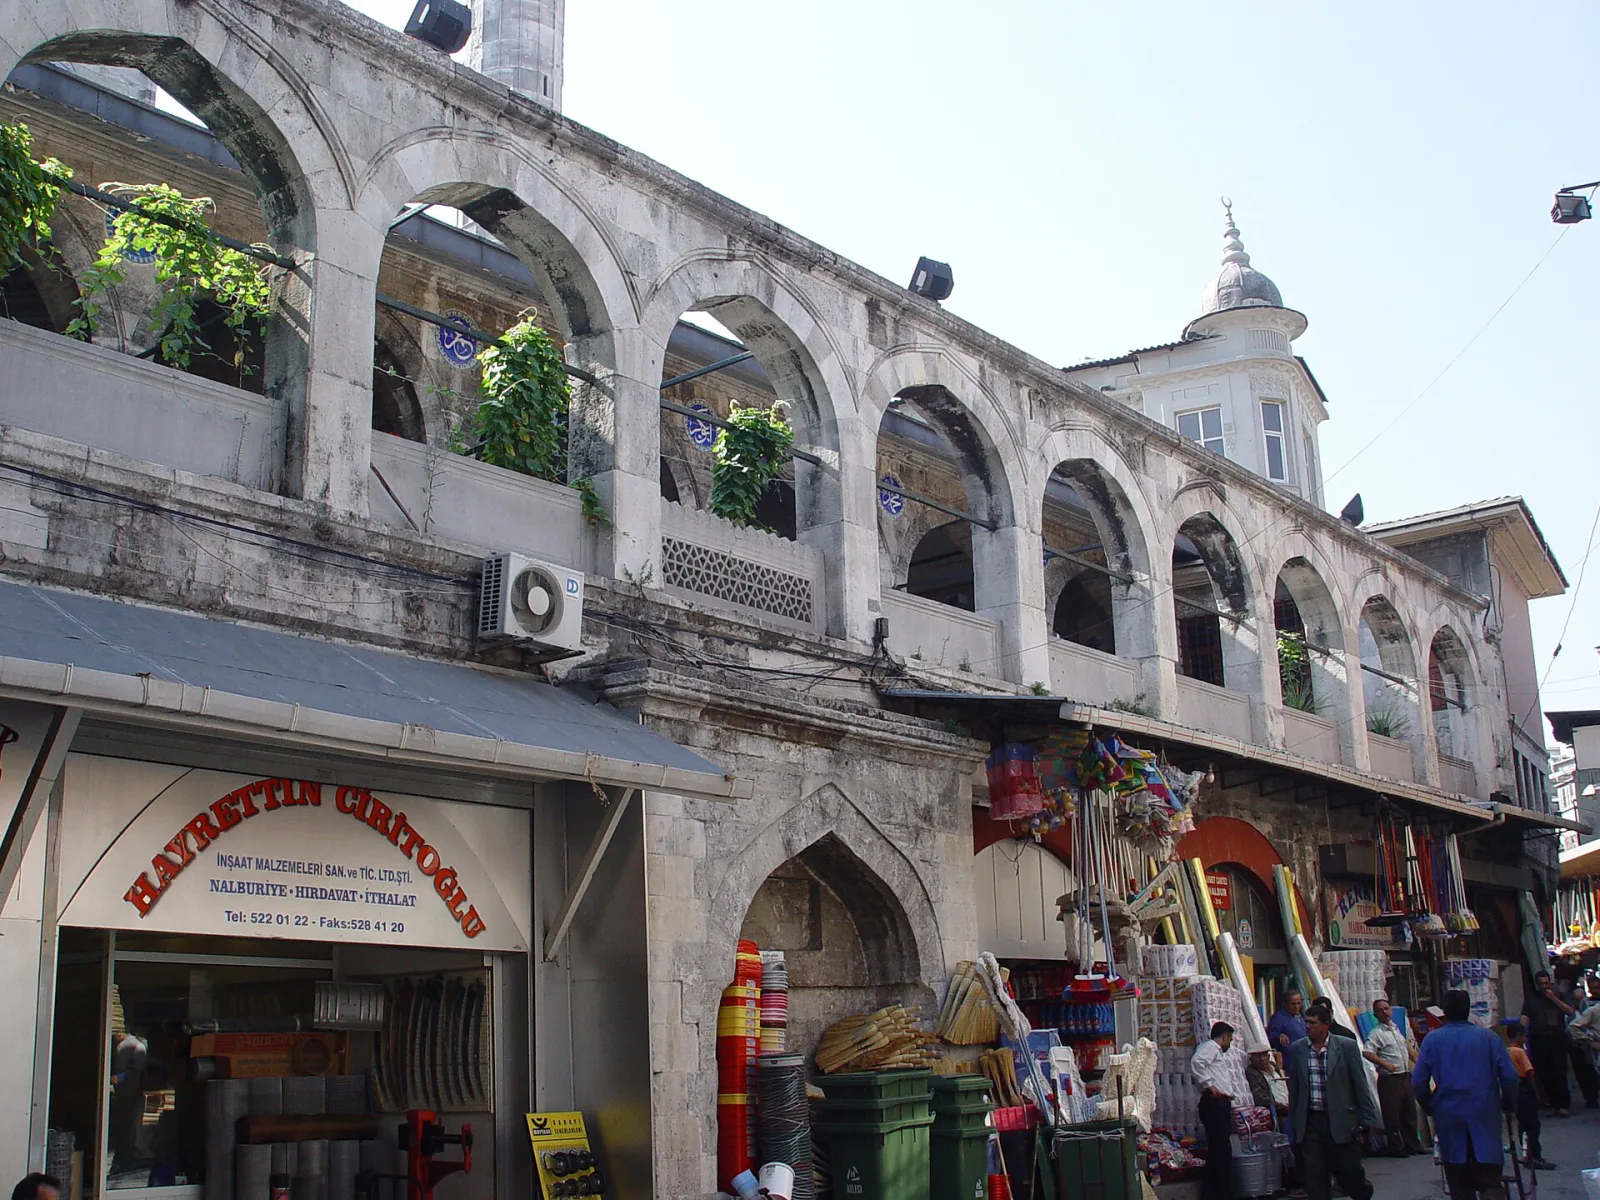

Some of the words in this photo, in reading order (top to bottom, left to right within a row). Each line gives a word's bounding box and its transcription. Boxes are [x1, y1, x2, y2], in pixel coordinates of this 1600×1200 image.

[216, 852, 253, 872] İNŞAAT
[255, 857, 323, 876] MALZEMELERİ
[325, 864, 346, 878] SAN.
[347, 868, 358, 879] ve
[360, 866, 377, 881] TİC.
[335, 785, 486, 938] CİRİTOĞLU
[209, 879, 288, 897] NALBURİYE
[295, 886, 358, 902] HIRDAVAT
[364, 887, 417, 907] İTHALAT
[225, 910, 247, 923] Tel:
[250, 912, 273, 925] 522
[276, 914, 290, 925] 01
[294, 915, 309, 926] 22
[319, 916, 371, 930] Faks:528
[374, 920, 387, 932] 41
[390, 922, 405, 933] 20
